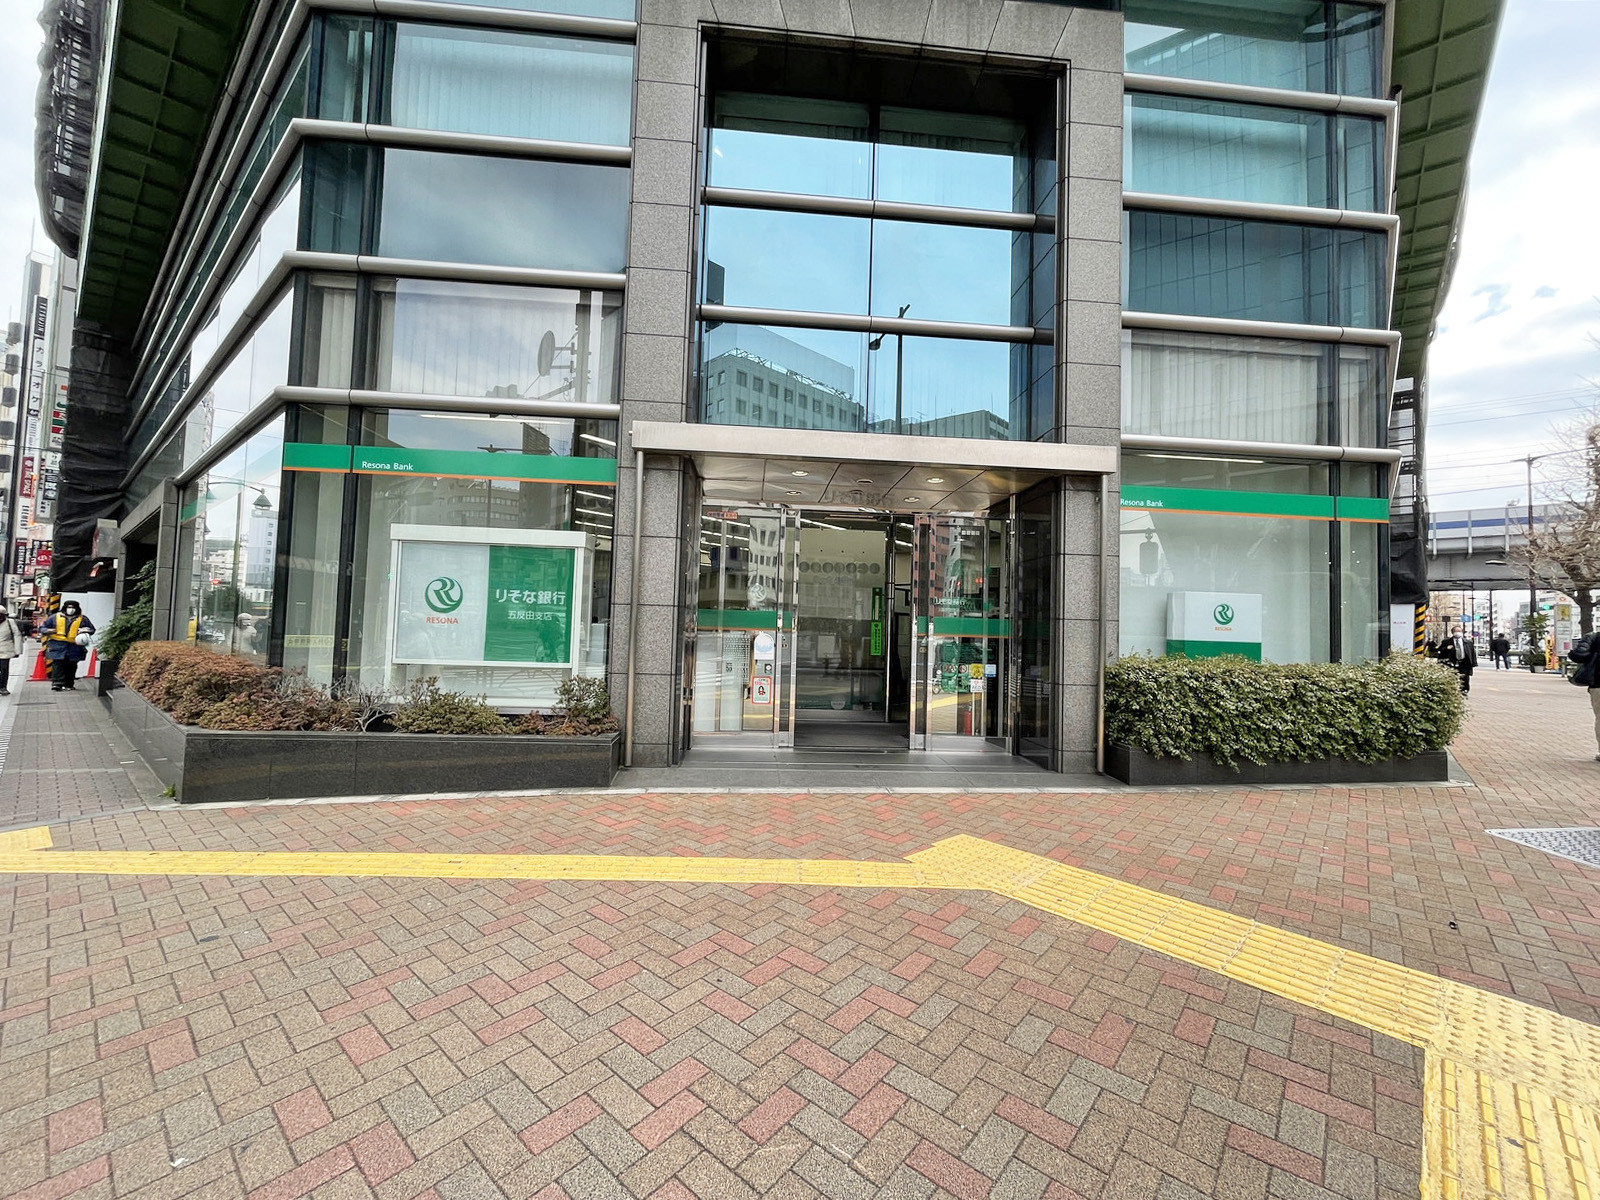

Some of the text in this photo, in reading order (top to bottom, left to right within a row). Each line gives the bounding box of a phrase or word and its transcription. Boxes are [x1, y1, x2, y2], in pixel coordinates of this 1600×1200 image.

[361, 460, 414, 471] Resona Bank
[1146, 499, 1164, 508] Bank
[495, 588, 566, 605] りそな銀行
[425, 616, 459, 625] RESONA
